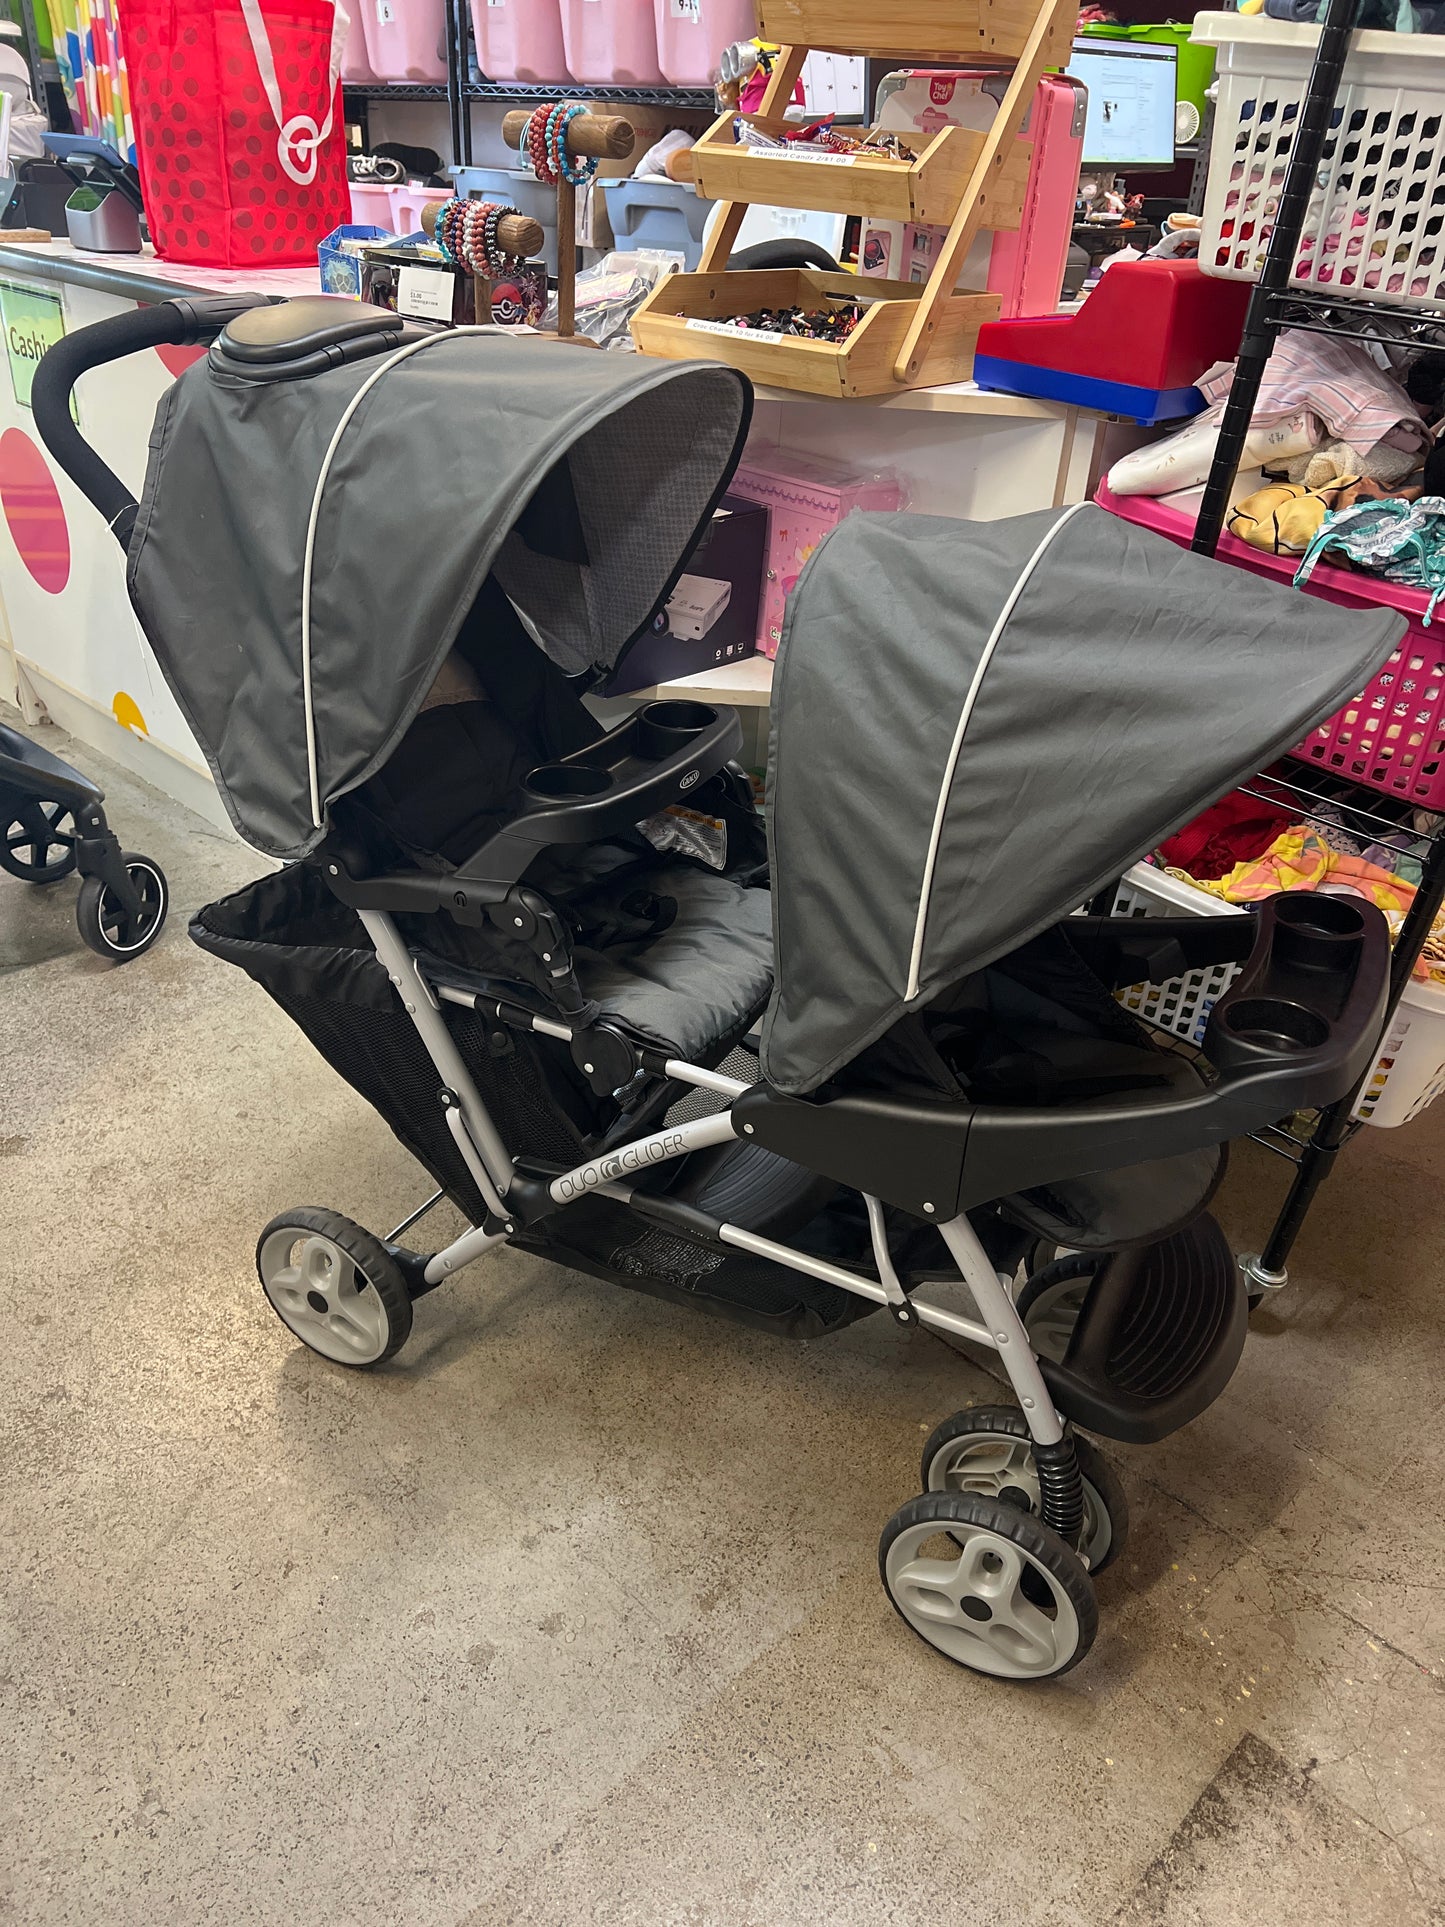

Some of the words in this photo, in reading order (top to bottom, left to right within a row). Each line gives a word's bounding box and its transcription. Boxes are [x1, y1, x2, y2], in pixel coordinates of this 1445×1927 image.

[384, 6, 389, 18] 6
[933, 82, 947, 92] Toy
[932, 91, 948, 100] Chef
[754, 149, 788, 158] Assorted
[693, 322, 707, 330] Croc
[709, 325, 733, 334] Charms
[560, 1167, 599, 1199] DUO
[622, 1133, 689, 1169] GLIDER
